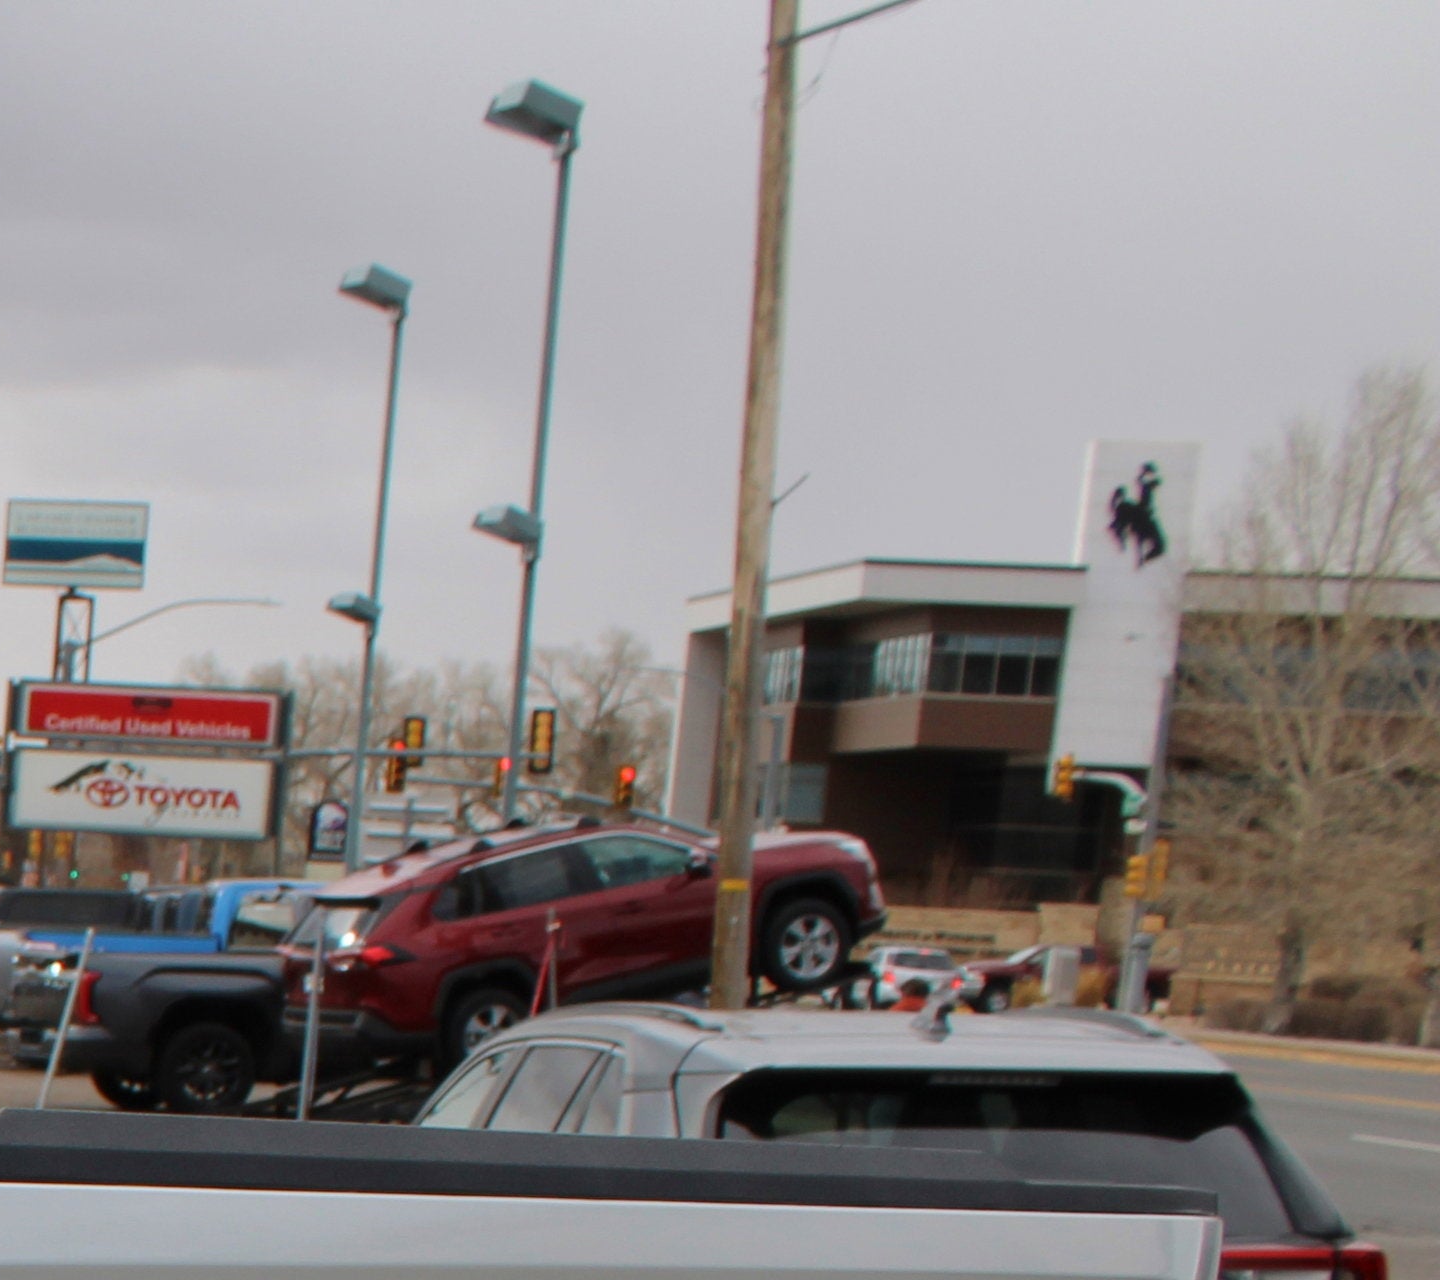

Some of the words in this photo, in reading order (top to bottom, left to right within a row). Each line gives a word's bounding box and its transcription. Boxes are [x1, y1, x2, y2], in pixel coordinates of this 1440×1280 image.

[44, 713, 121, 734] Certified
[125, 716, 173, 737] Used
[177, 720, 252, 740] Vehicles
[134, 785, 241, 811] TOYOTA
